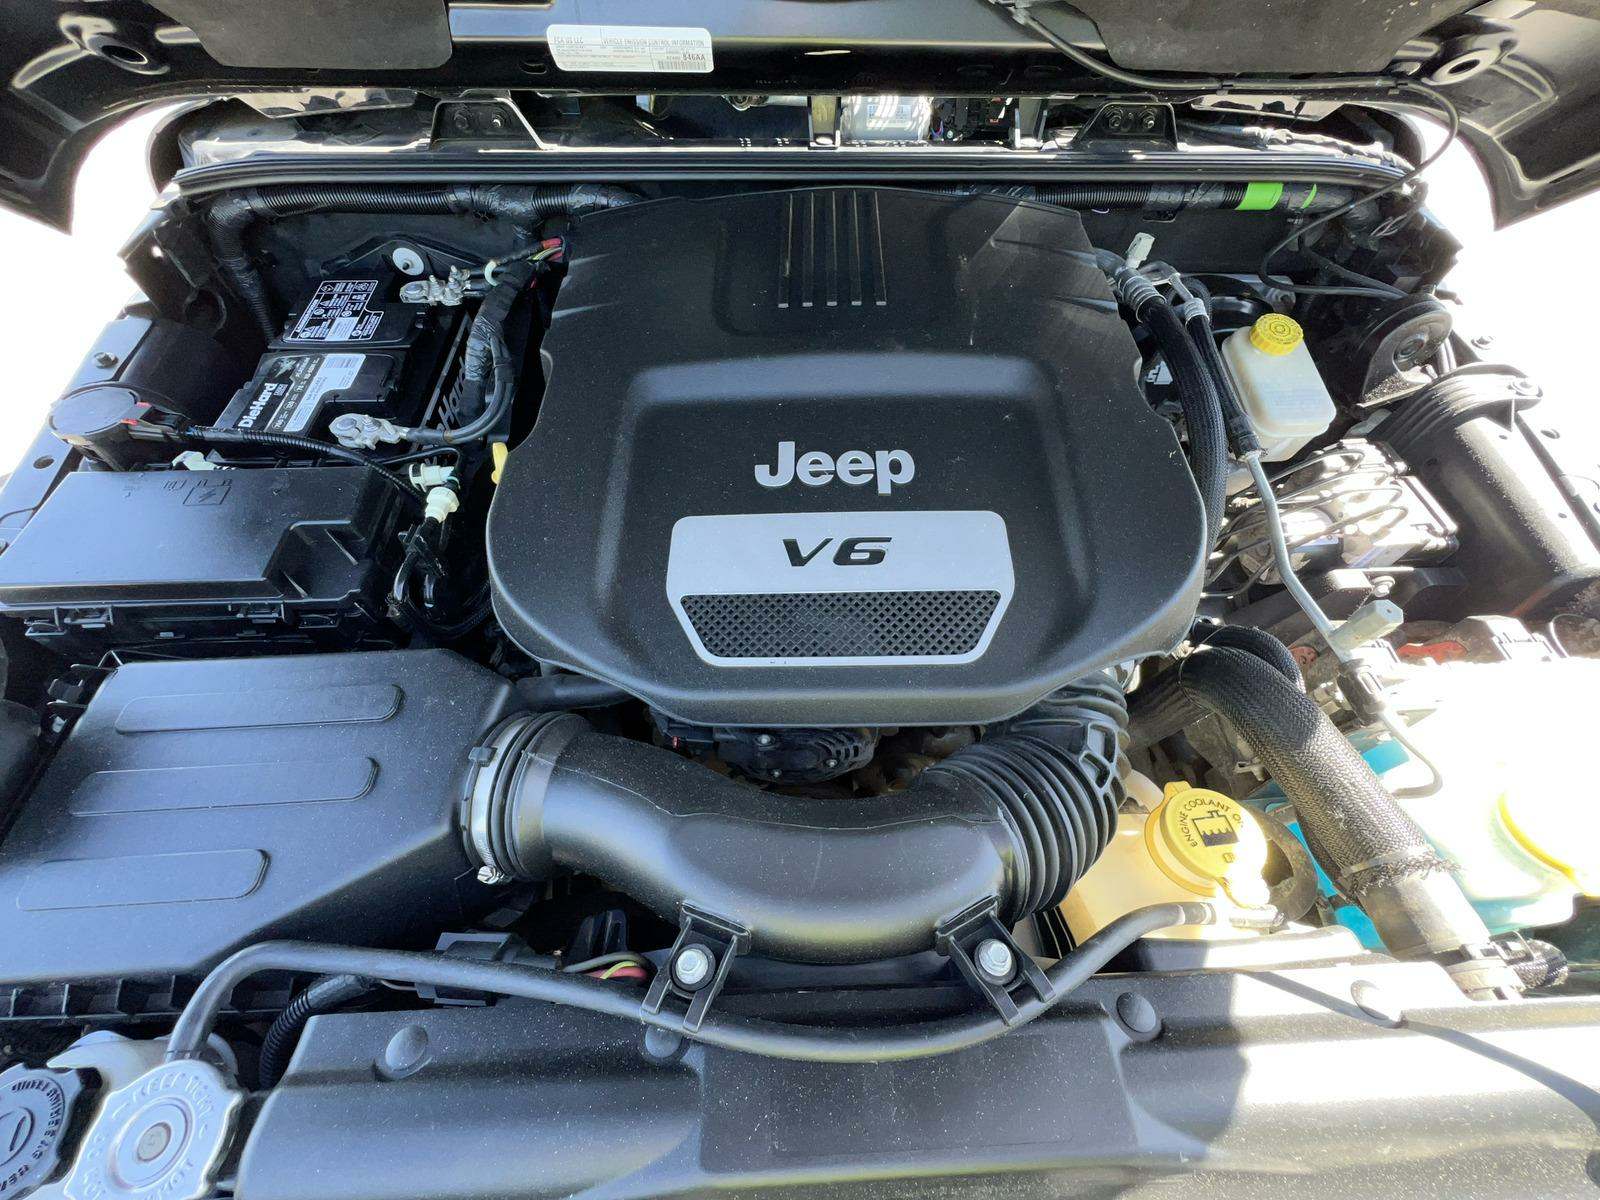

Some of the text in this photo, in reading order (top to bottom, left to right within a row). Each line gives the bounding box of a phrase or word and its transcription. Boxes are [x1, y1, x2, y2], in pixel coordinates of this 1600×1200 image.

[238, 383, 277, 428] DieHard
[754, 441, 916, 496] Jeep
[782, 537, 892, 567] V6
[1178, 798, 1230, 847] ENGINE COOLANT
